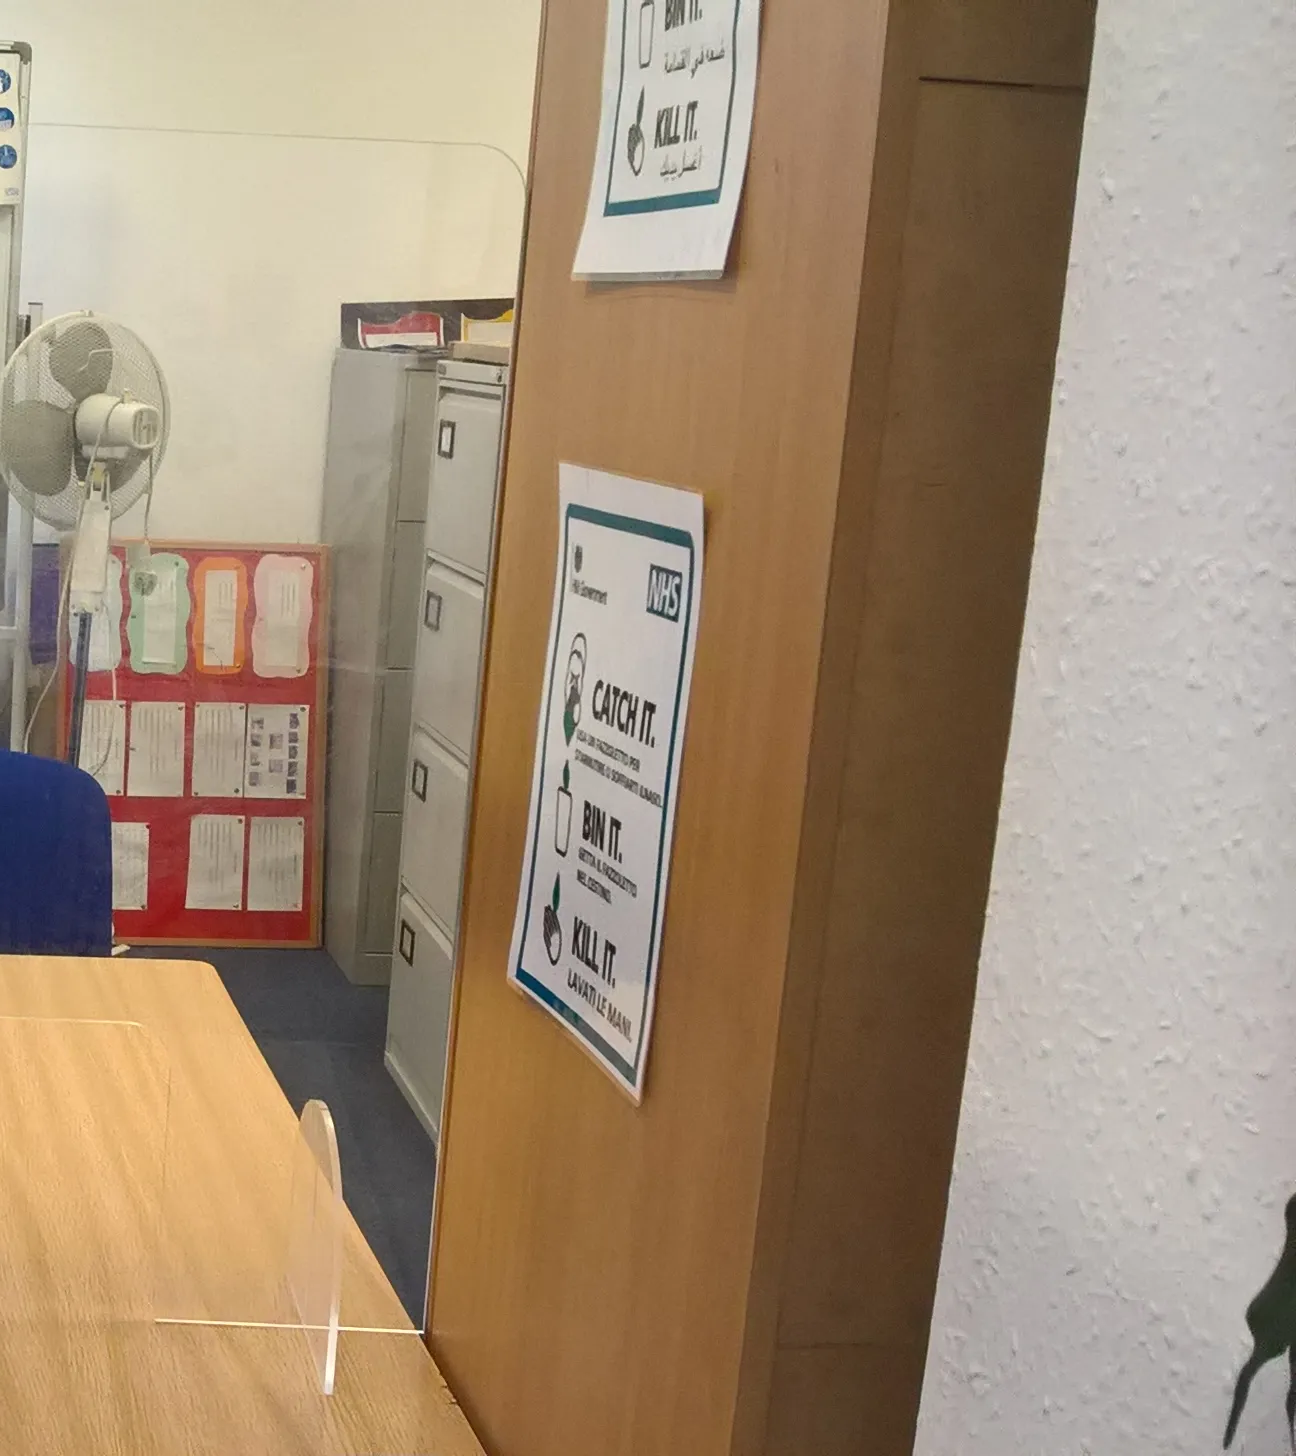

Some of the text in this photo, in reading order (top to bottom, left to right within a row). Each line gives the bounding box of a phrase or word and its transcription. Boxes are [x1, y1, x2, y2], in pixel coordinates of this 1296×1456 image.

[664, 0, 685, 32] BIN
[654, 100, 699, 149] KILL IT.
[647, 567, 681, 618] NHS
[592, 679, 657, 748] CATCH IT.
[582, 799, 623, 864] BIN IT.
[571, 915, 616, 989] KILL IT.
[567, 967, 597, 1009] LAVATI
